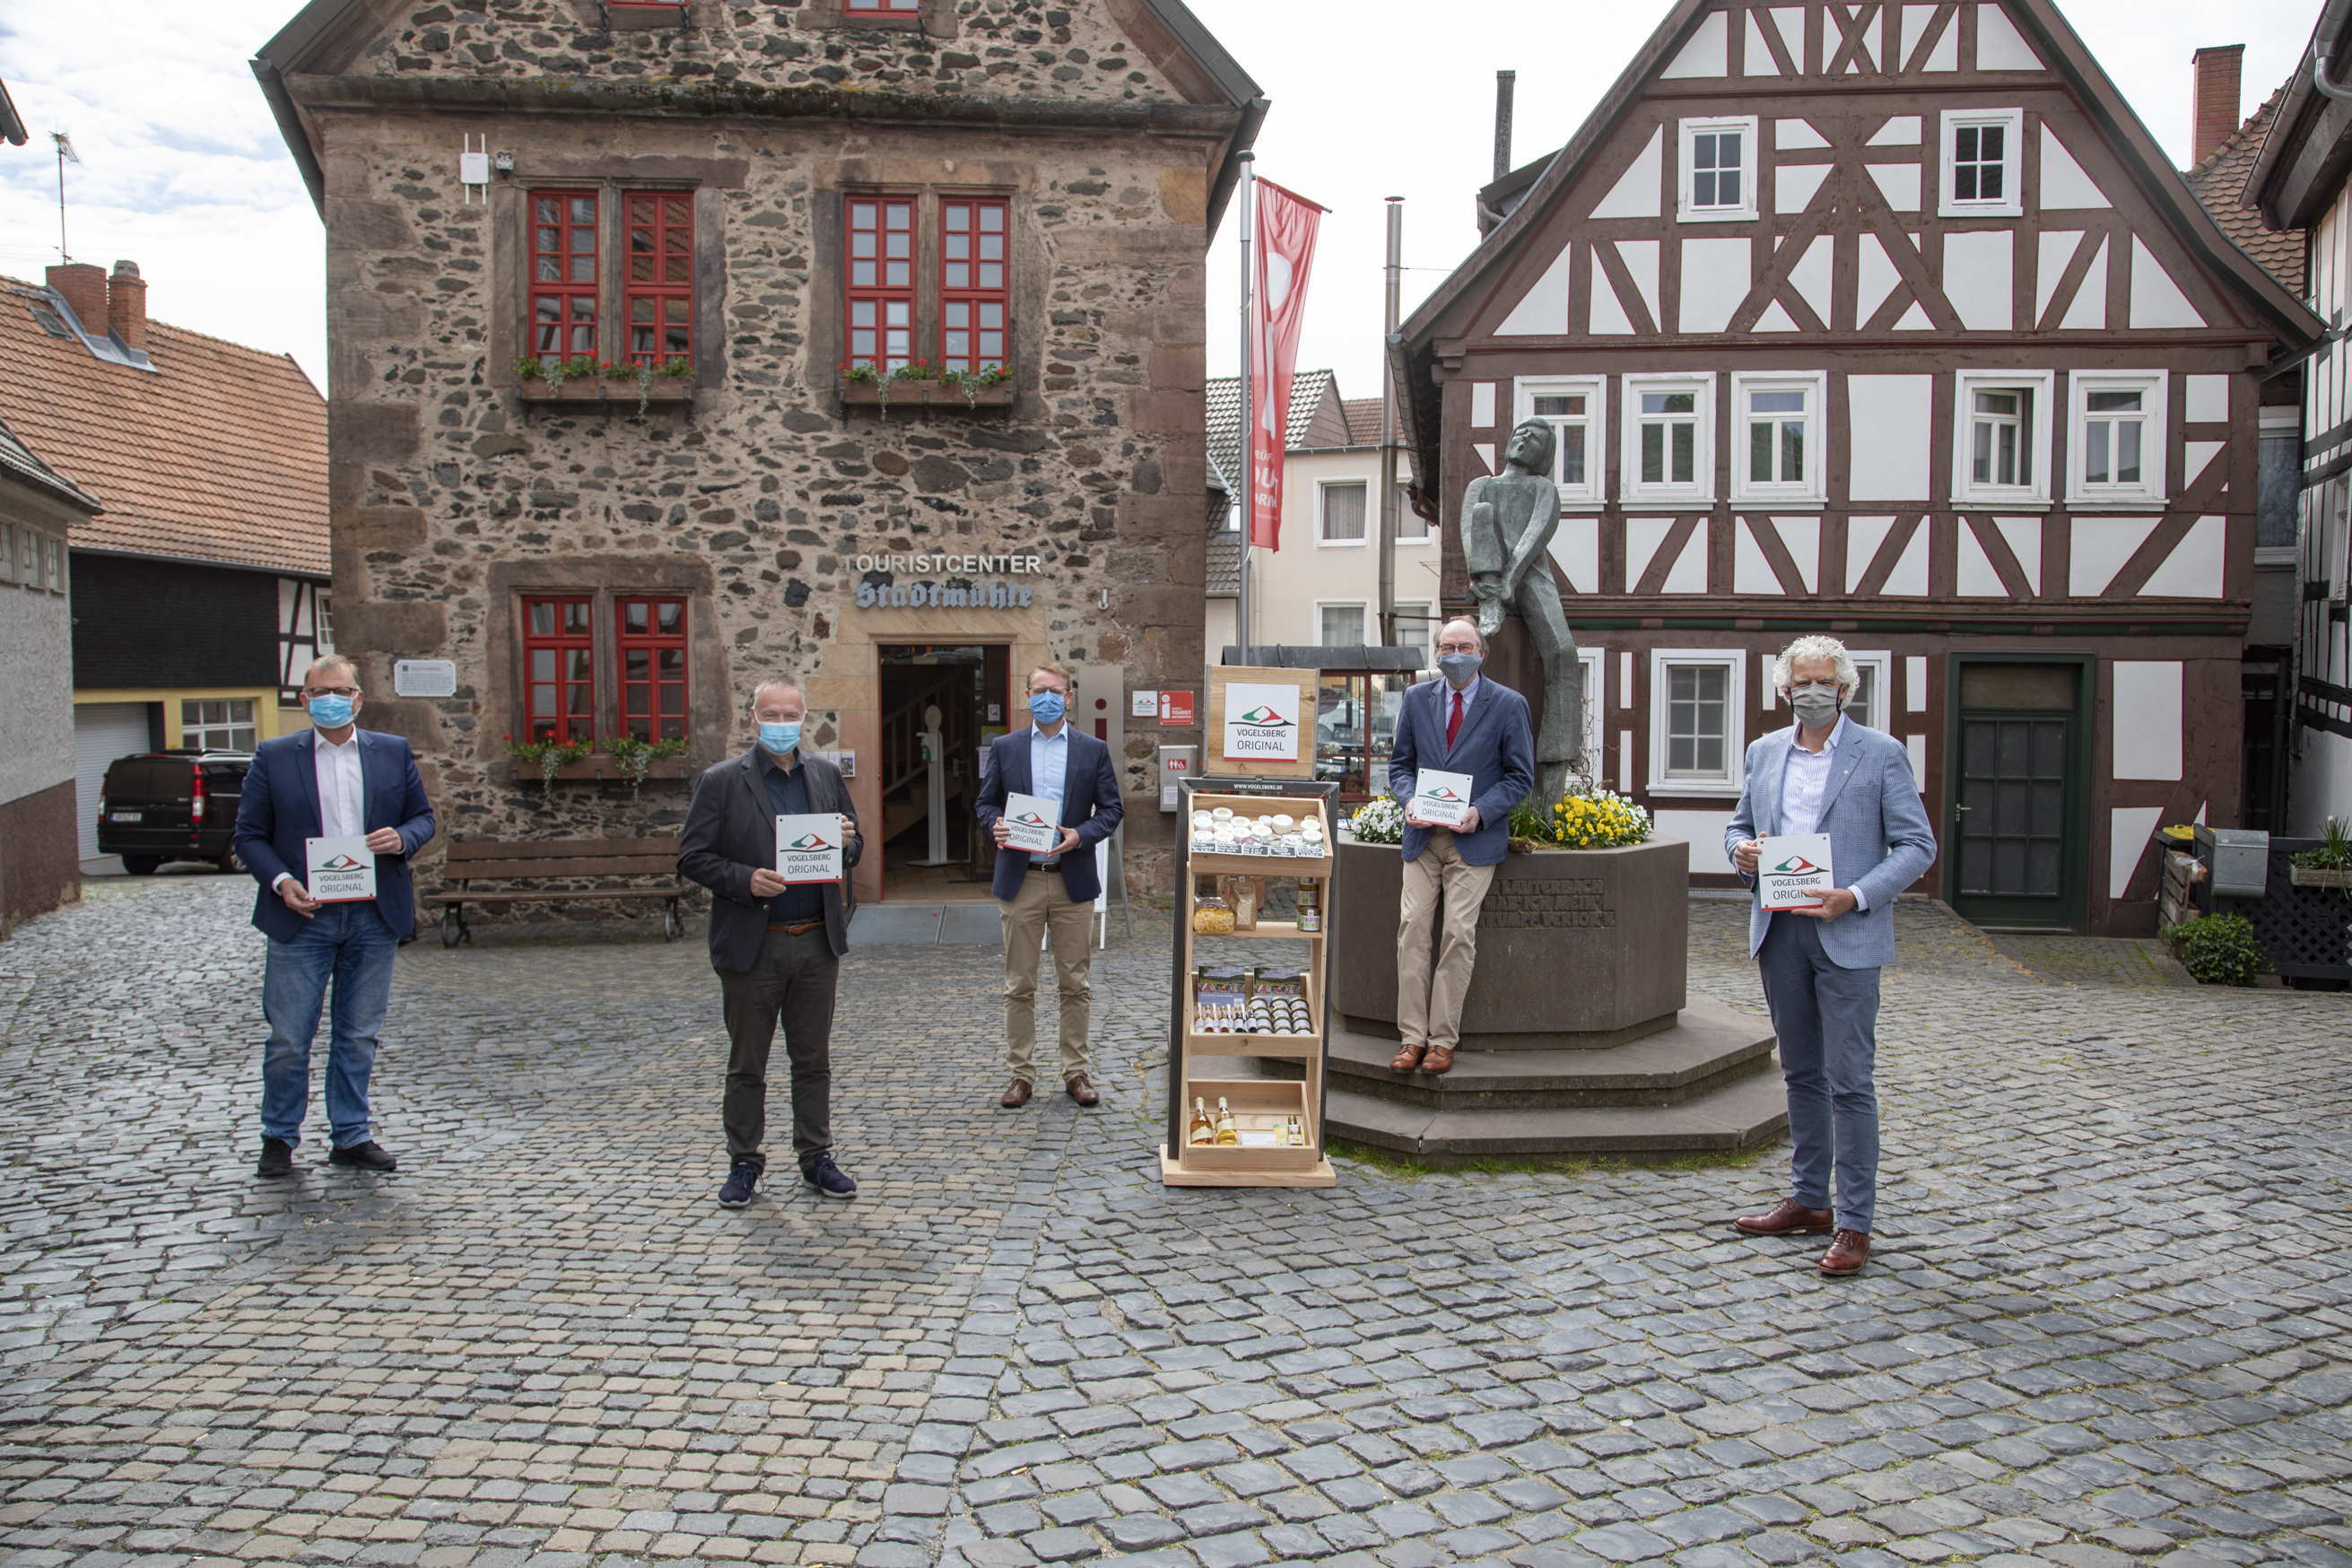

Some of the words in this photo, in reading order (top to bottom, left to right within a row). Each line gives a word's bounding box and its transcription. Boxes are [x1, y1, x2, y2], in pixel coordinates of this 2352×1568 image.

[844, 554, 1041, 573] TOURISTCENTER
[855, 581, 1033, 609] Stadtmühle
[1237, 728, 1286, 737] VOGELSBERG
[1237, 740, 1285, 751] ORIGINAL
[1423, 800, 1459, 810] VOGELSBERG
[1422, 808, 1457, 819] ORIGINAL
[1011, 825, 1046, 836] VOGELSBERG
[1009, 833, 1043, 845] ORIGINAL
[788, 854, 832, 862] VOGELSBERG
[788, 864, 831, 874] ORIGINAL
[319, 873, 364, 882] VOGELSBERG
[1772, 877, 1821, 886] VOGELSBERG
[320, 883, 364, 893] ORIGINAL
